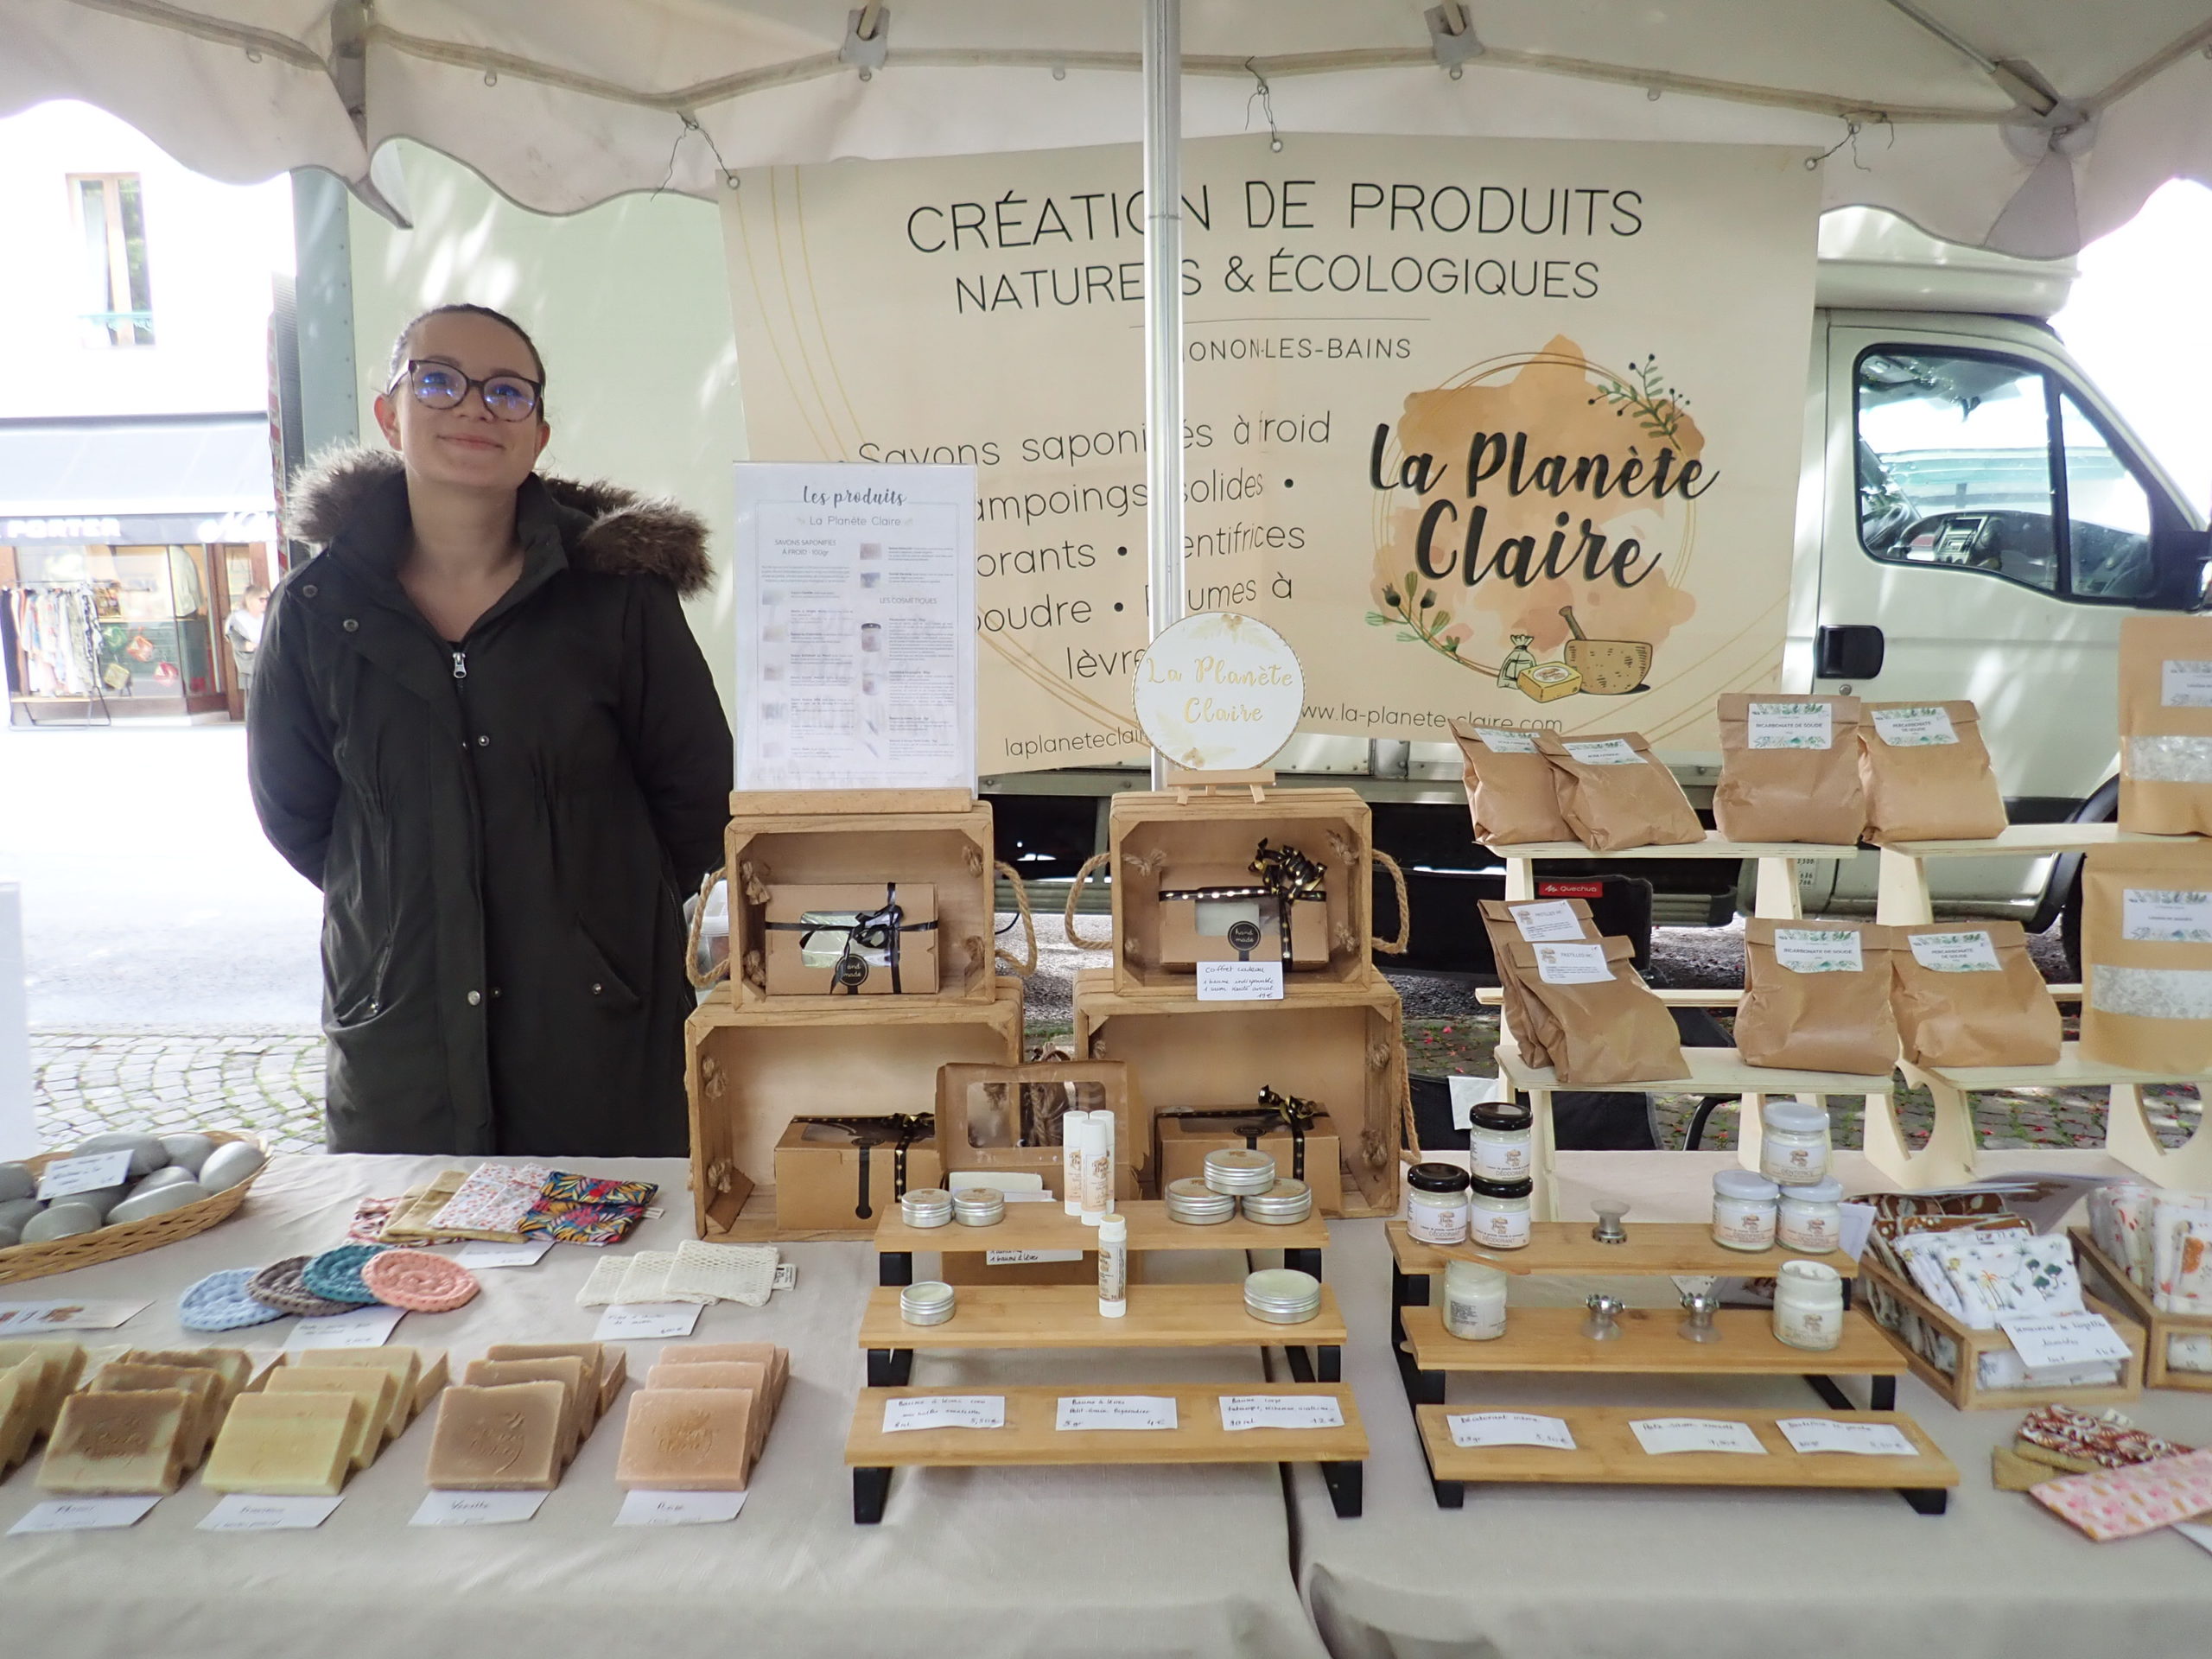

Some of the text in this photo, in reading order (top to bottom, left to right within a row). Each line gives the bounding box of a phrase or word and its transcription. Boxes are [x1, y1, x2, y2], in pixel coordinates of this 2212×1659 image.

[1244, 180, 1316, 229] DE
[1350, 182, 1643, 237] PRODUITS
[956, 247, 1599, 315] NATURES & ÉCOLOGIQUES
[1183, 338, 1411, 361] ONON-LES-BAINS
[1021, 423, 1213, 467] saponiés
[1233, 414, 1249, 445] à
[1370, 423, 1720, 499] La Planète
[803, 485, 907, 509] Les produits
[810, 515, 901, 526] La Planète Claire
[977, 483, 1148, 526] mpoings
[977, 540, 1096, 578] orants
[1184, 521, 1306, 559] entifrices
[1414, 499, 1662, 588] Claire
[977, 594, 1092, 632] oudre
[1271, 571, 1293, 600] à
[1066, 646, 1145, 680] lèvr
[1146, 656, 1294, 687] La Planète
[1184, 696, 1263, 724] Claire
